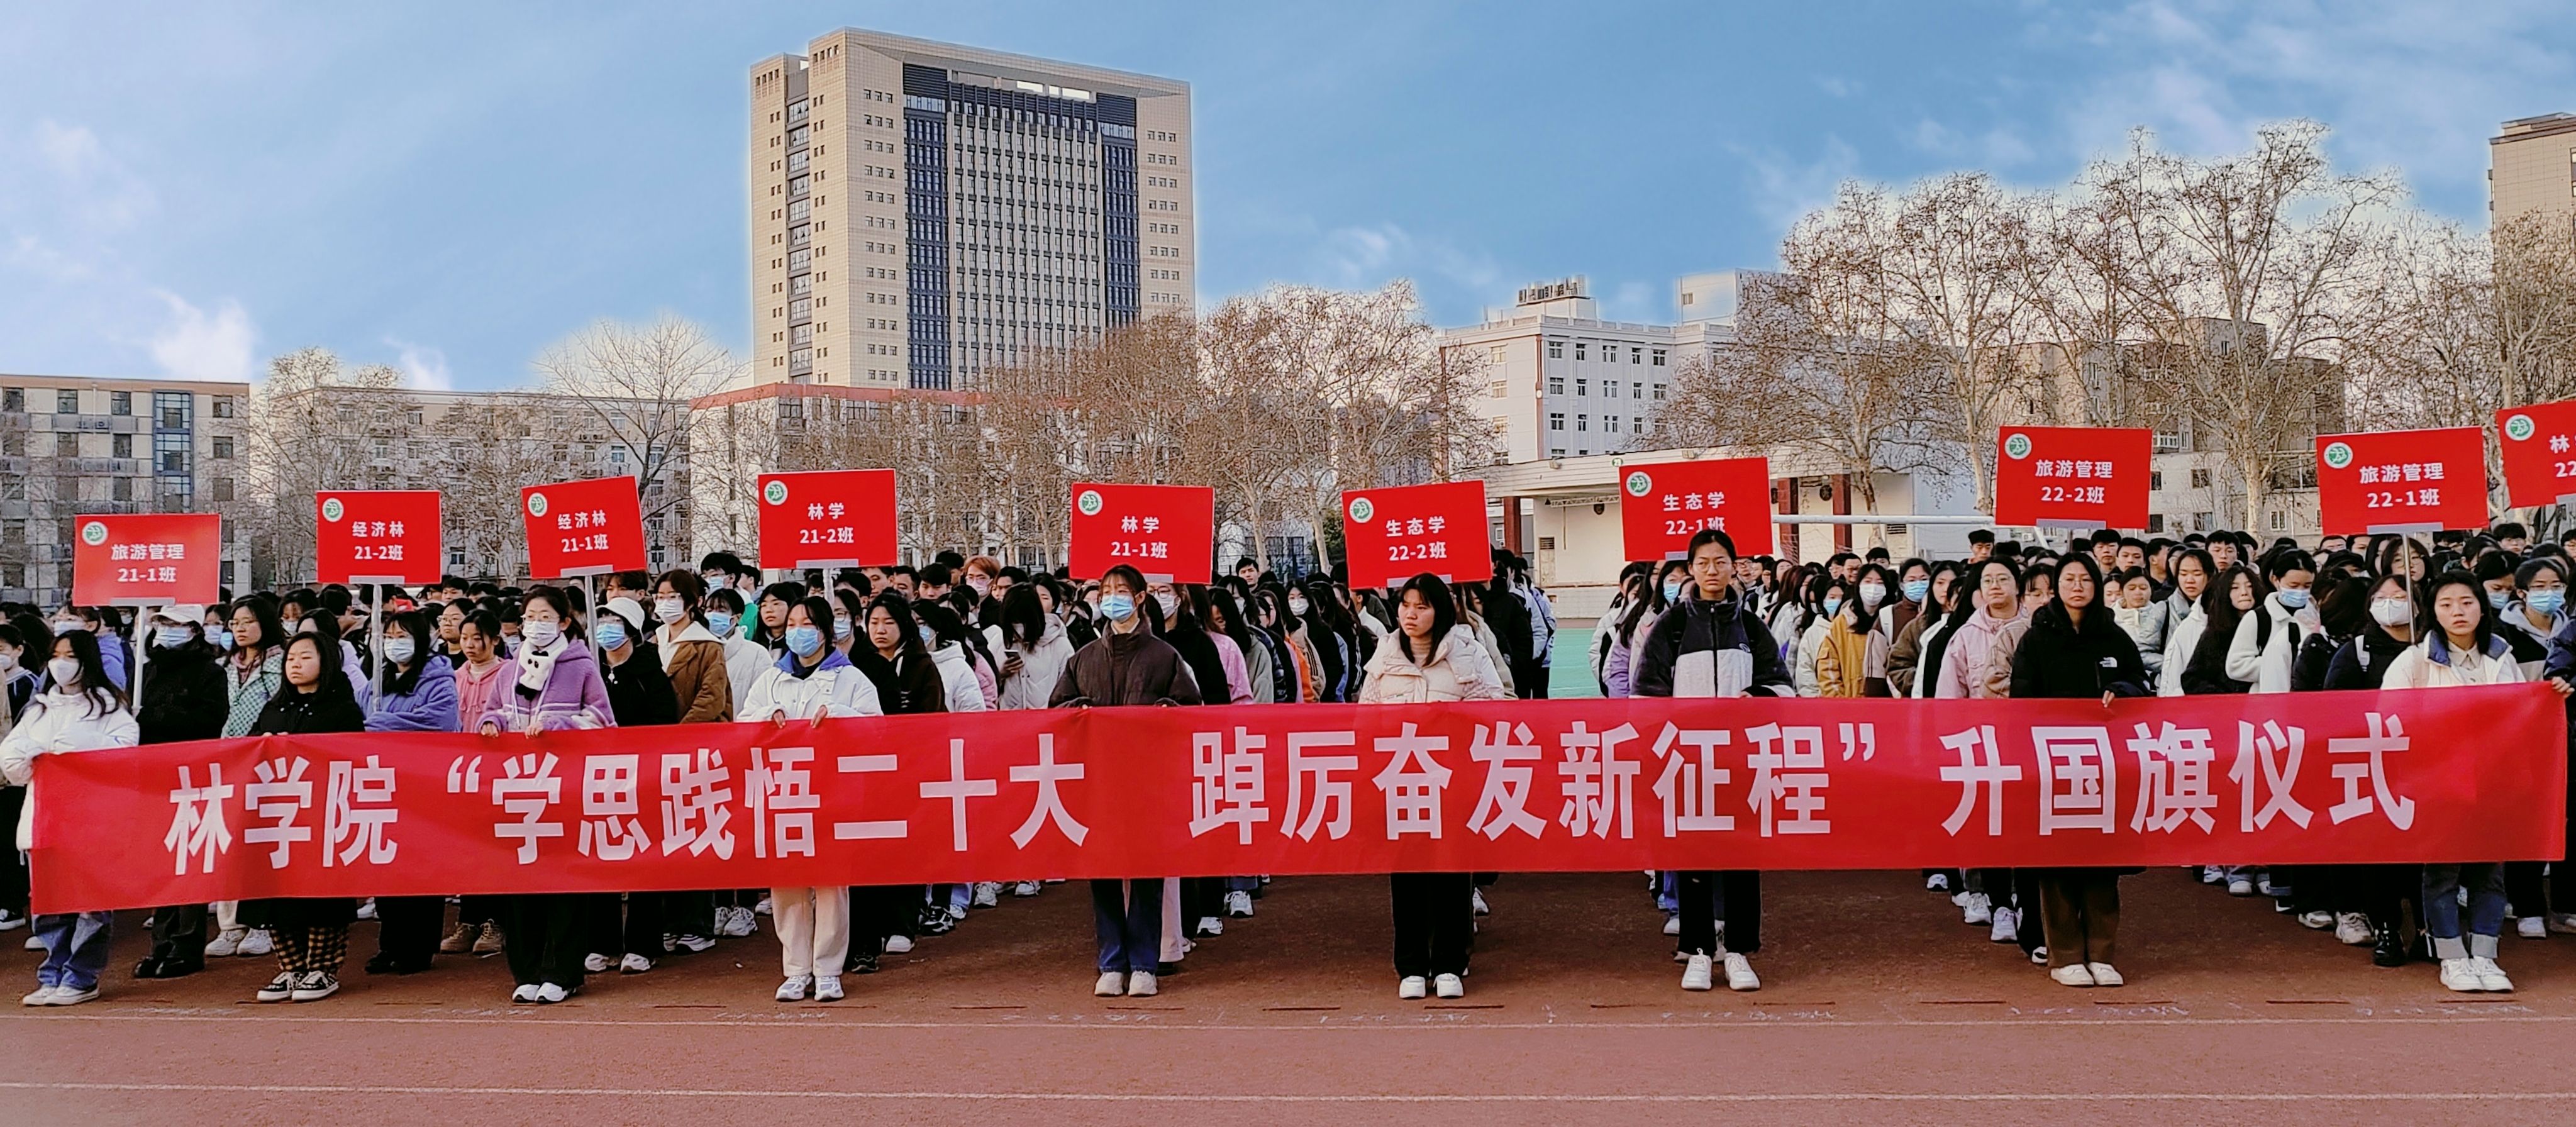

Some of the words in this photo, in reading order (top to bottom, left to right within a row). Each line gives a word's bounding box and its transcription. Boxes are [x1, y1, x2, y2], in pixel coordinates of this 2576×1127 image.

[2549, 434, 2576, 453] 林
[2035, 459, 2112, 478] 旅游管理
[2359, 462, 2445, 484] 旅游管理
[1663, 491, 1725, 511] 生态学
[2041, 486, 2105, 504] 22-2班
[2367, 488, 2441, 508] 22-1班
[557, 509, 606, 530] 经济林
[808, 502, 845, 520] 林学
[352, 521, 404, 538] 经济林
[1121, 516, 1159, 534] 林学
[1385, 516, 1445, 537] 生态学
[1665, 516, 1726, 534] 22-1班
[561, 533, 609, 553] 21-1班
[800, 526, 854, 543] 21-2班
[111, 543, 185, 561] 旅游管理
[354, 544, 403, 560] 21-2班
[1111, 541, 1168, 558] 21-1班
[1389, 541, 1447, 561] 22-2班
[117, 565, 177, 583] 21-1班
